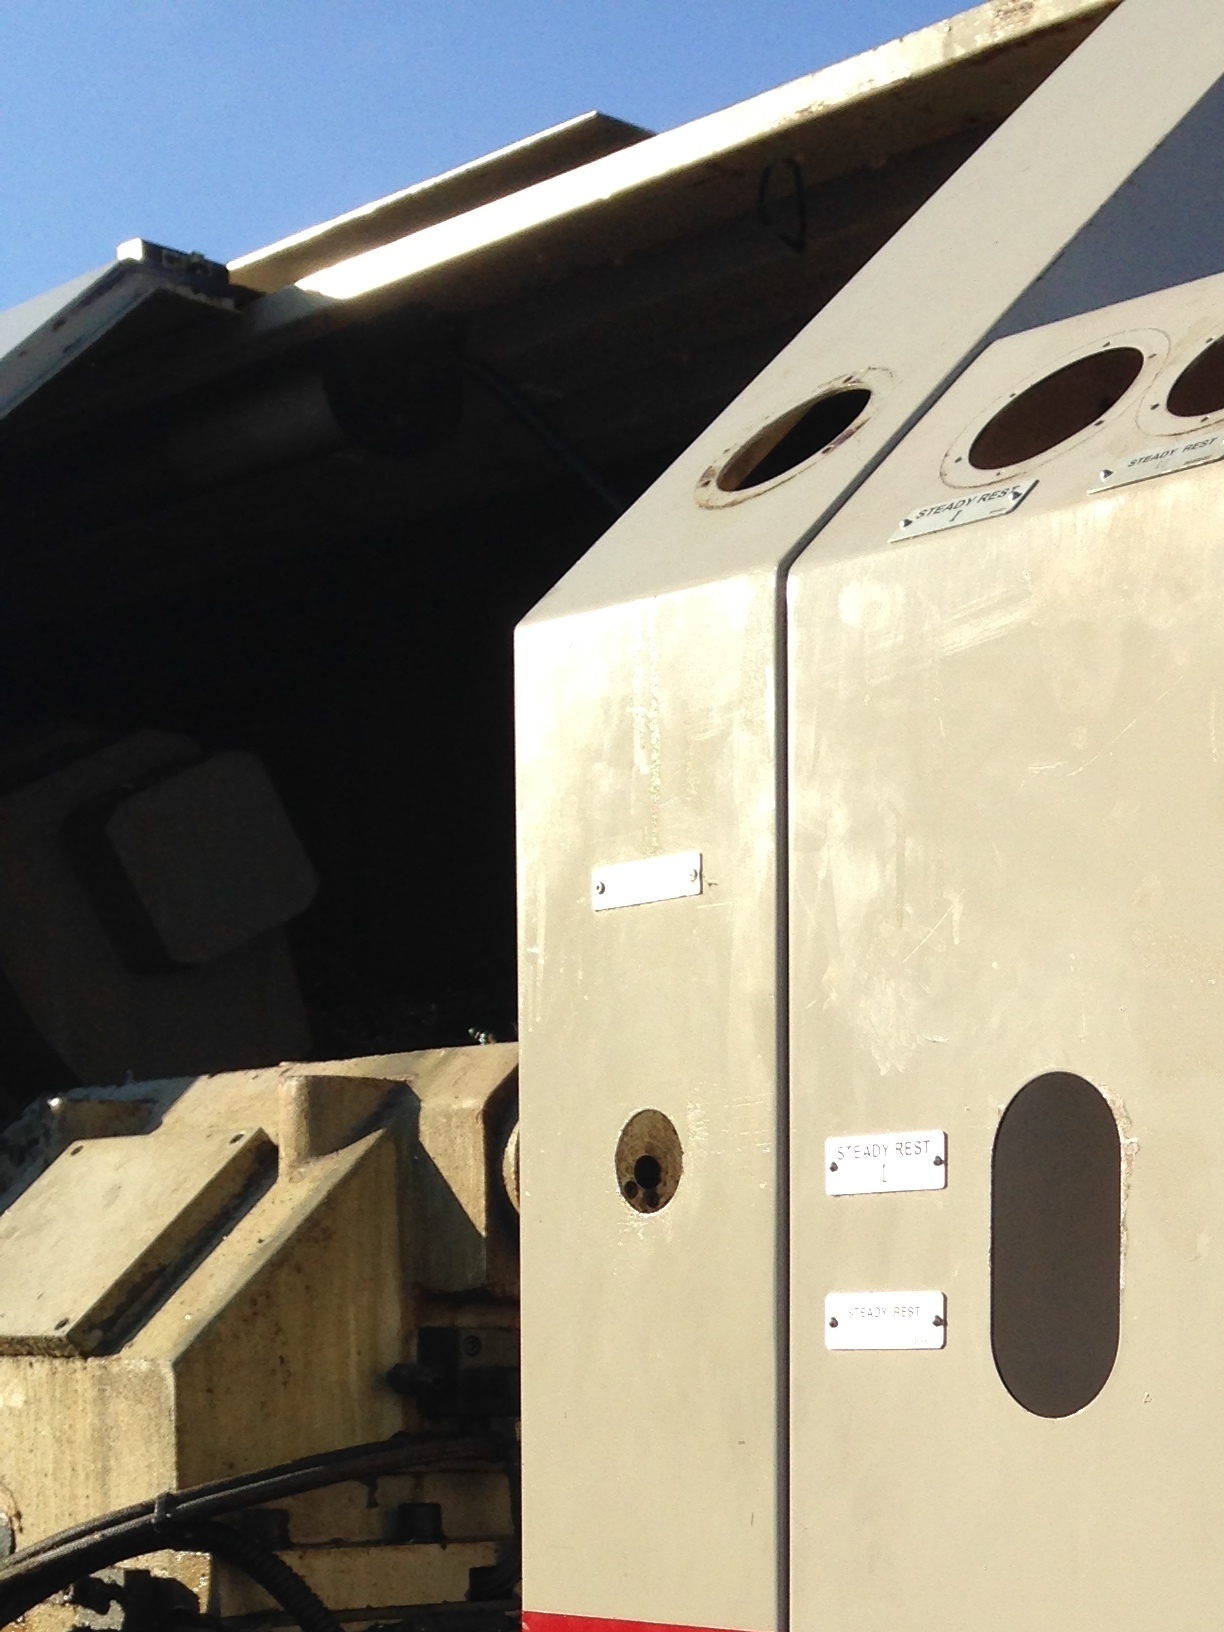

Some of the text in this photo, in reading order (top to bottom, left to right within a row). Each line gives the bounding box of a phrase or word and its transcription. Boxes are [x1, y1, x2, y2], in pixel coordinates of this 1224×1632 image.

[1128, 447, 1180, 468] STEADY
[1182, 436, 1219, 453] REST
[915, 484, 1021, 519] STEADY REST
[836, 1139, 931, 1161] STEADY REST
[848, 1305, 921, 1319] STEADY REST
